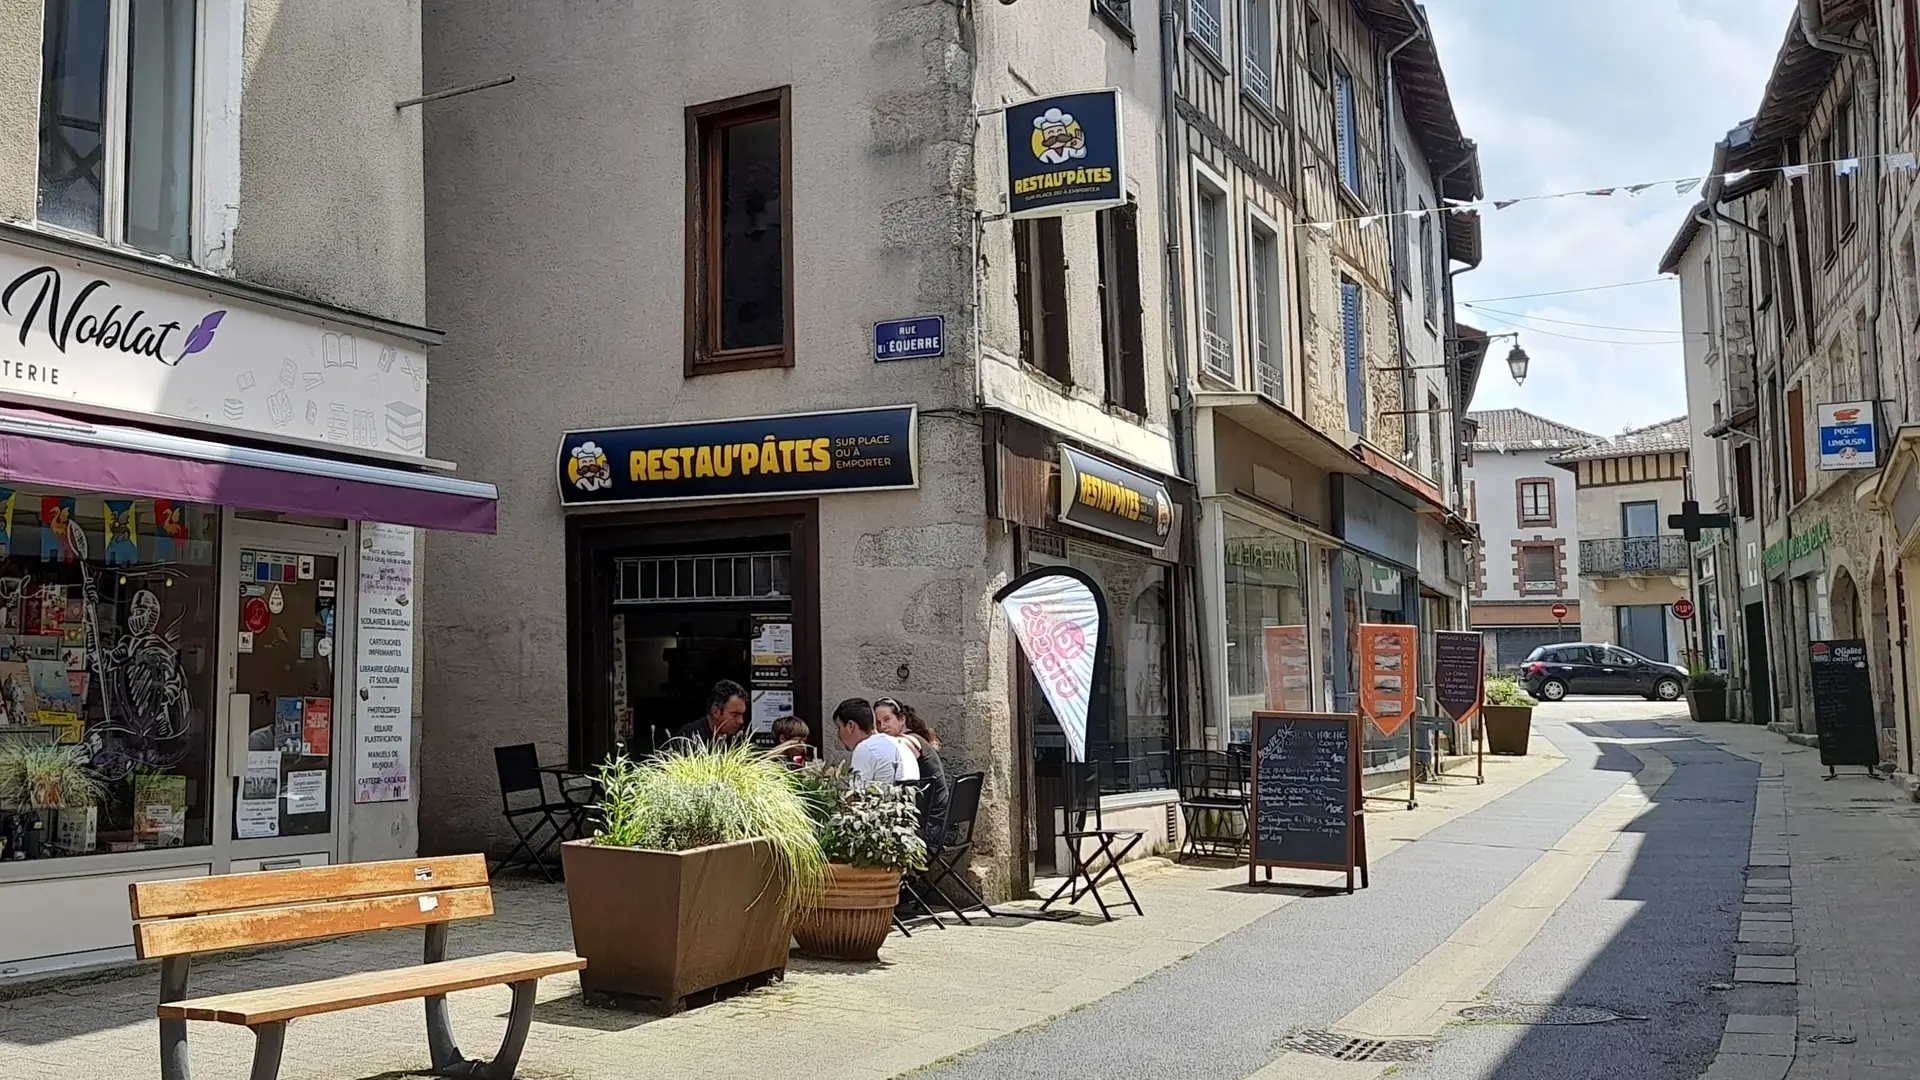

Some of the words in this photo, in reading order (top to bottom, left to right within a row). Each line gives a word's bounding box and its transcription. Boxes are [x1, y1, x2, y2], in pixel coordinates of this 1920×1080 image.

[1014, 166, 1112, 194] RESTAU'PÂTES
[1068, 186, 1100, 194] EMPORTER
[2, 266, 180, 366] Noblat
[899, 326, 916, 335] RUE
[1833, 427, 1859, 436] PORC
[835, 437, 856, 448] SUR
[858, 434, 890, 446] PLACE
[1828, 438, 1866, 447] LIMOUSIN
[834, 448, 851, 458] OU
[852, 446, 860, 457] À
[629, 434, 831, 482] RESTAU'PÂTES
[836, 457, 892, 470] EMPORTER
[1078, 472, 1140, 521] RESTAU'PÂTES
[369, 607, 402, 616] FOURNITURES
[1675, 604, 1692, 614] STOP
[360, 618, 386, 626] SCOLAIRES
[392, 619, 410, 627] BUREAU
[369, 638, 402, 646] CARTOUCHES
[368, 649, 402, 657] IMPRIMANTES
[360, 665, 383, 673] LIBRAIRIE
[384, 665, 410, 674] GÉNÉRALE
[376, 677, 400, 685] SCOLAIRE
[372, 761, 394, 770] MUSIQUE
